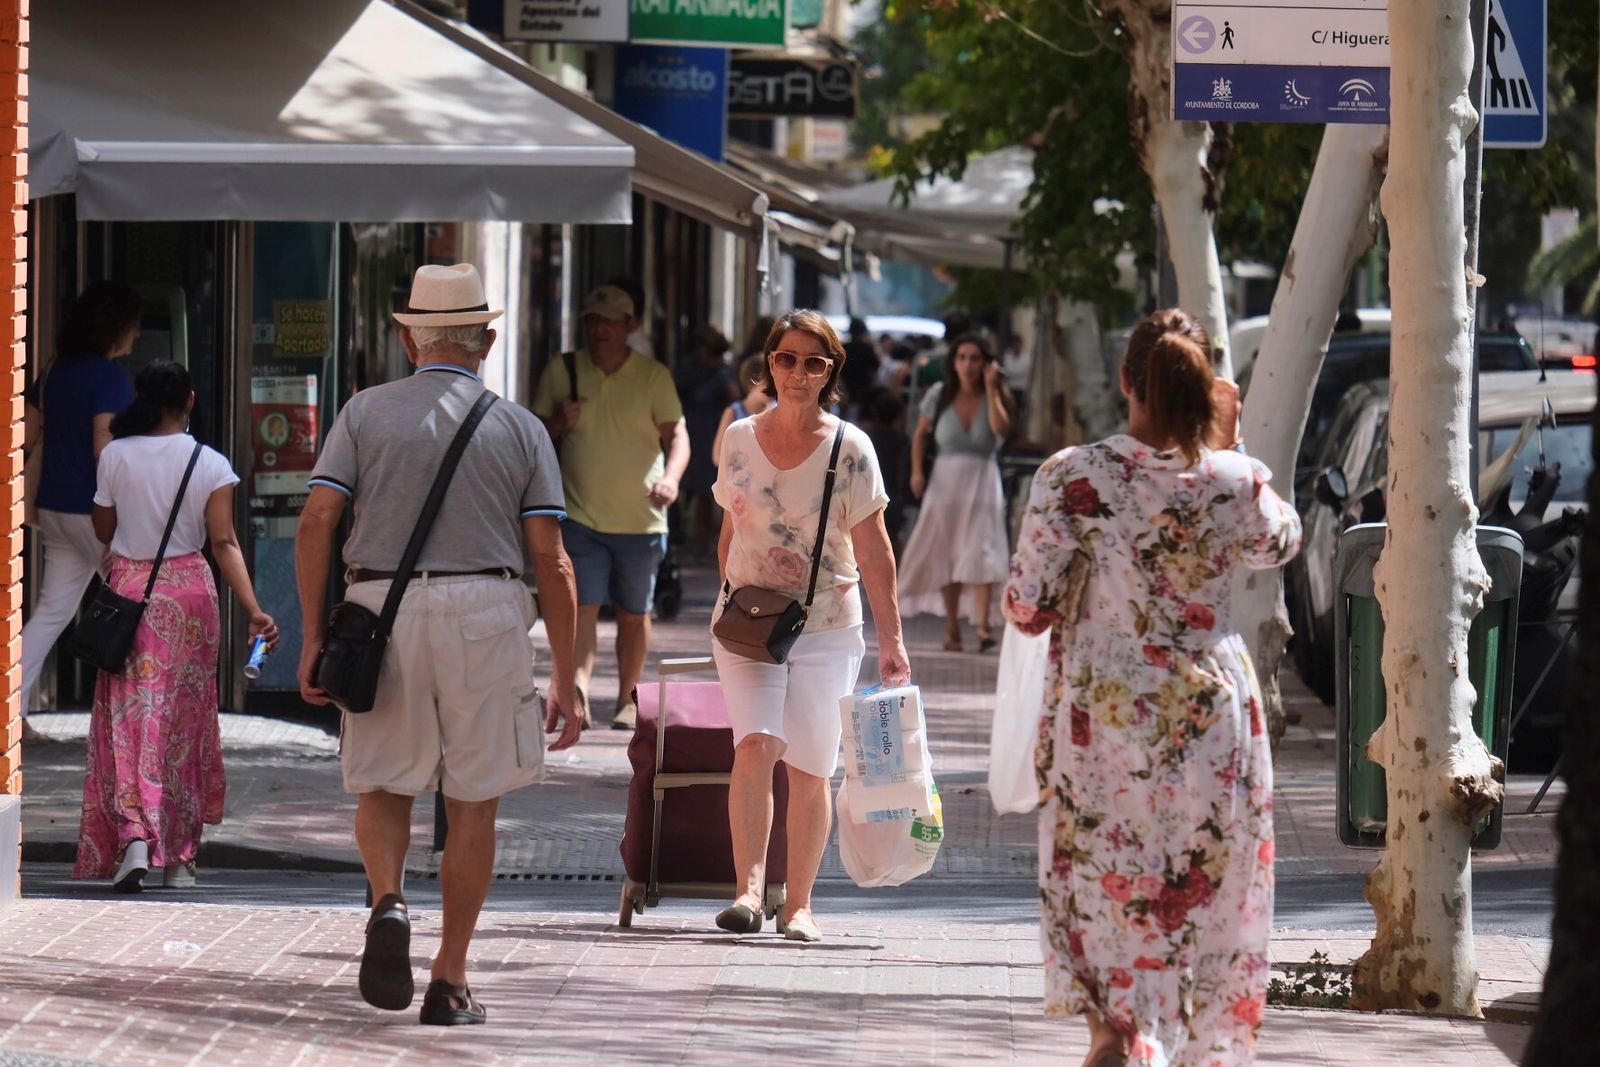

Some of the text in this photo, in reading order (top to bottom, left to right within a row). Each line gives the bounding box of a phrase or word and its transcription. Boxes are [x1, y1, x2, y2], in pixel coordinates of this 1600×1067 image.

[582, 5, 600, 17] del
[1311, 30, 1328, 44] C/
[1184, 101, 1226, 109] AYUNTAMIENTO
[281, 306, 294, 322] Se
[879, 701, 892, 755] doble rollo
